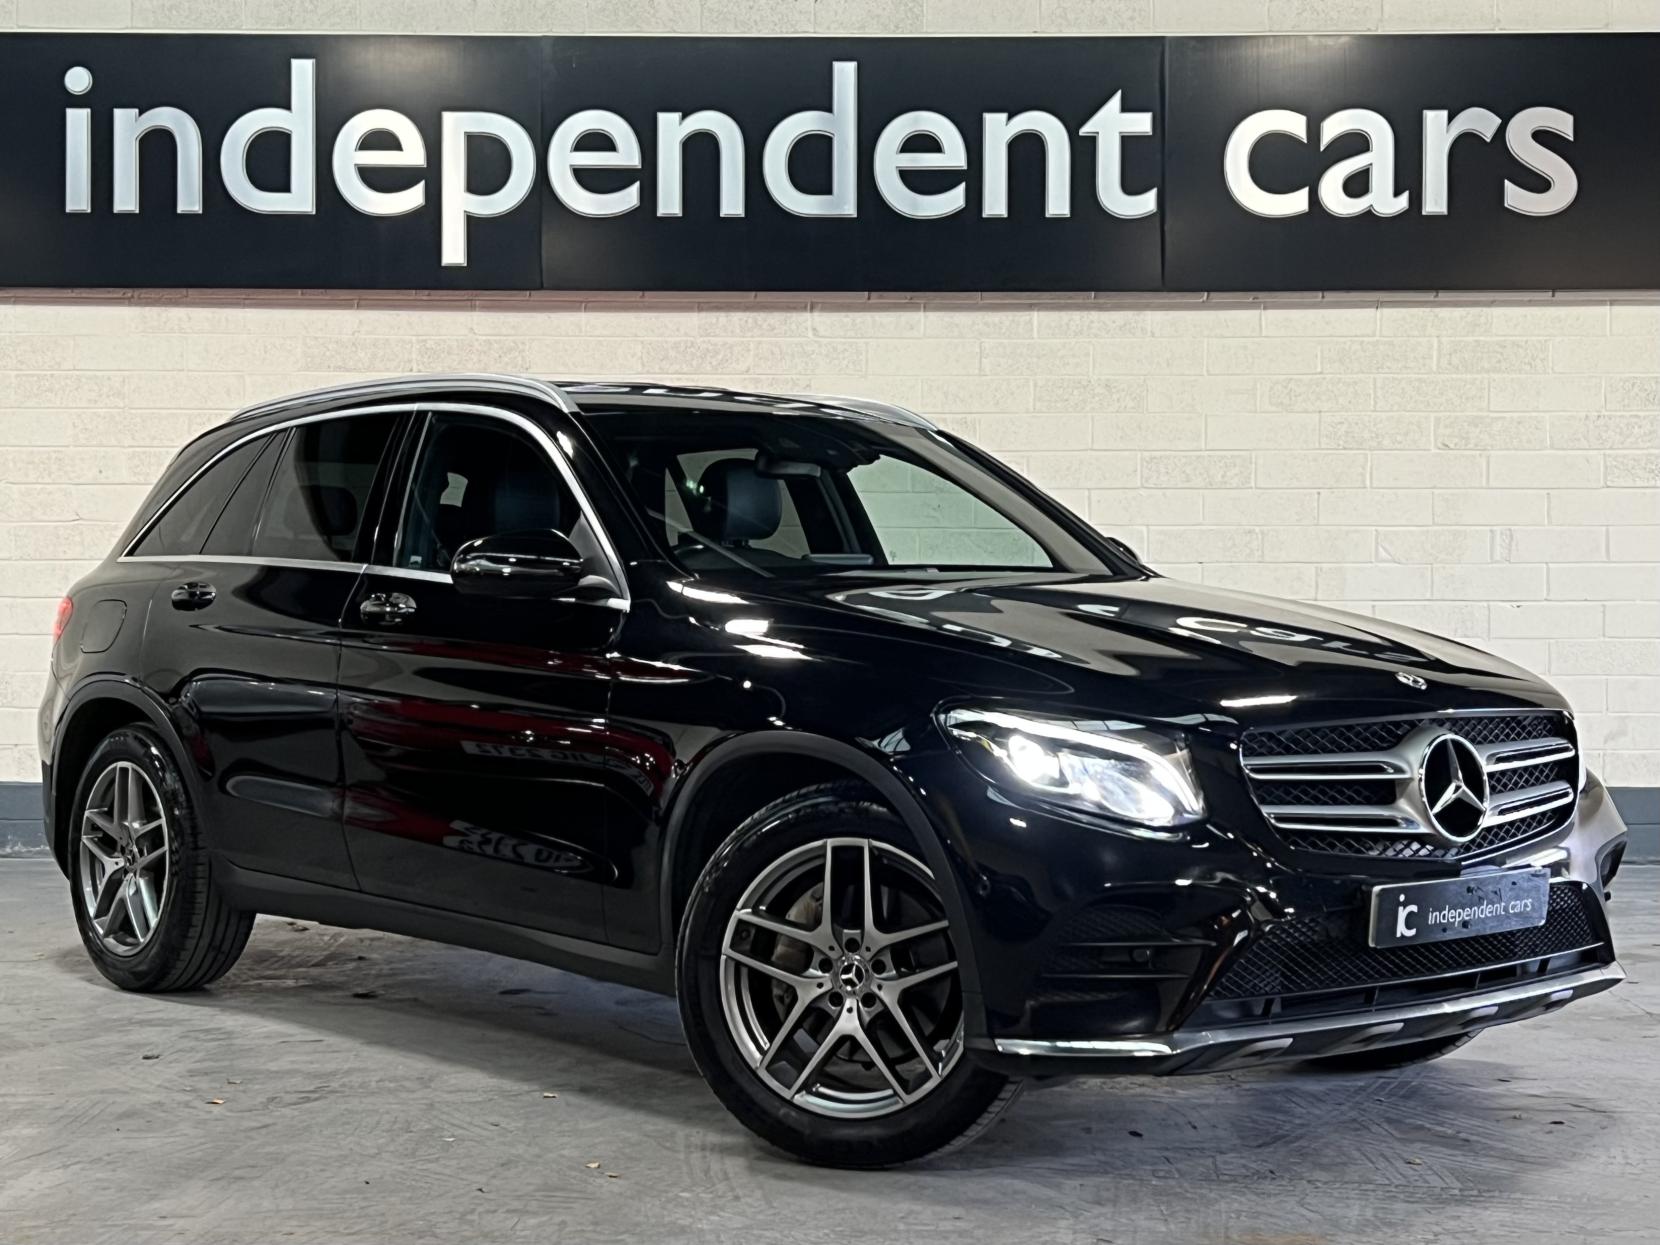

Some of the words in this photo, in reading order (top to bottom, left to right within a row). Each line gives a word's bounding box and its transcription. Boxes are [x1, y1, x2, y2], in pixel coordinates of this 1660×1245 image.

[64, 57, 1159, 267] independent
[1222, 106, 1580, 218] cars
[1396, 893, 1418, 938] ic
[1428, 899, 1506, 927] independent
[1509, 897, 1532, 912] cars
